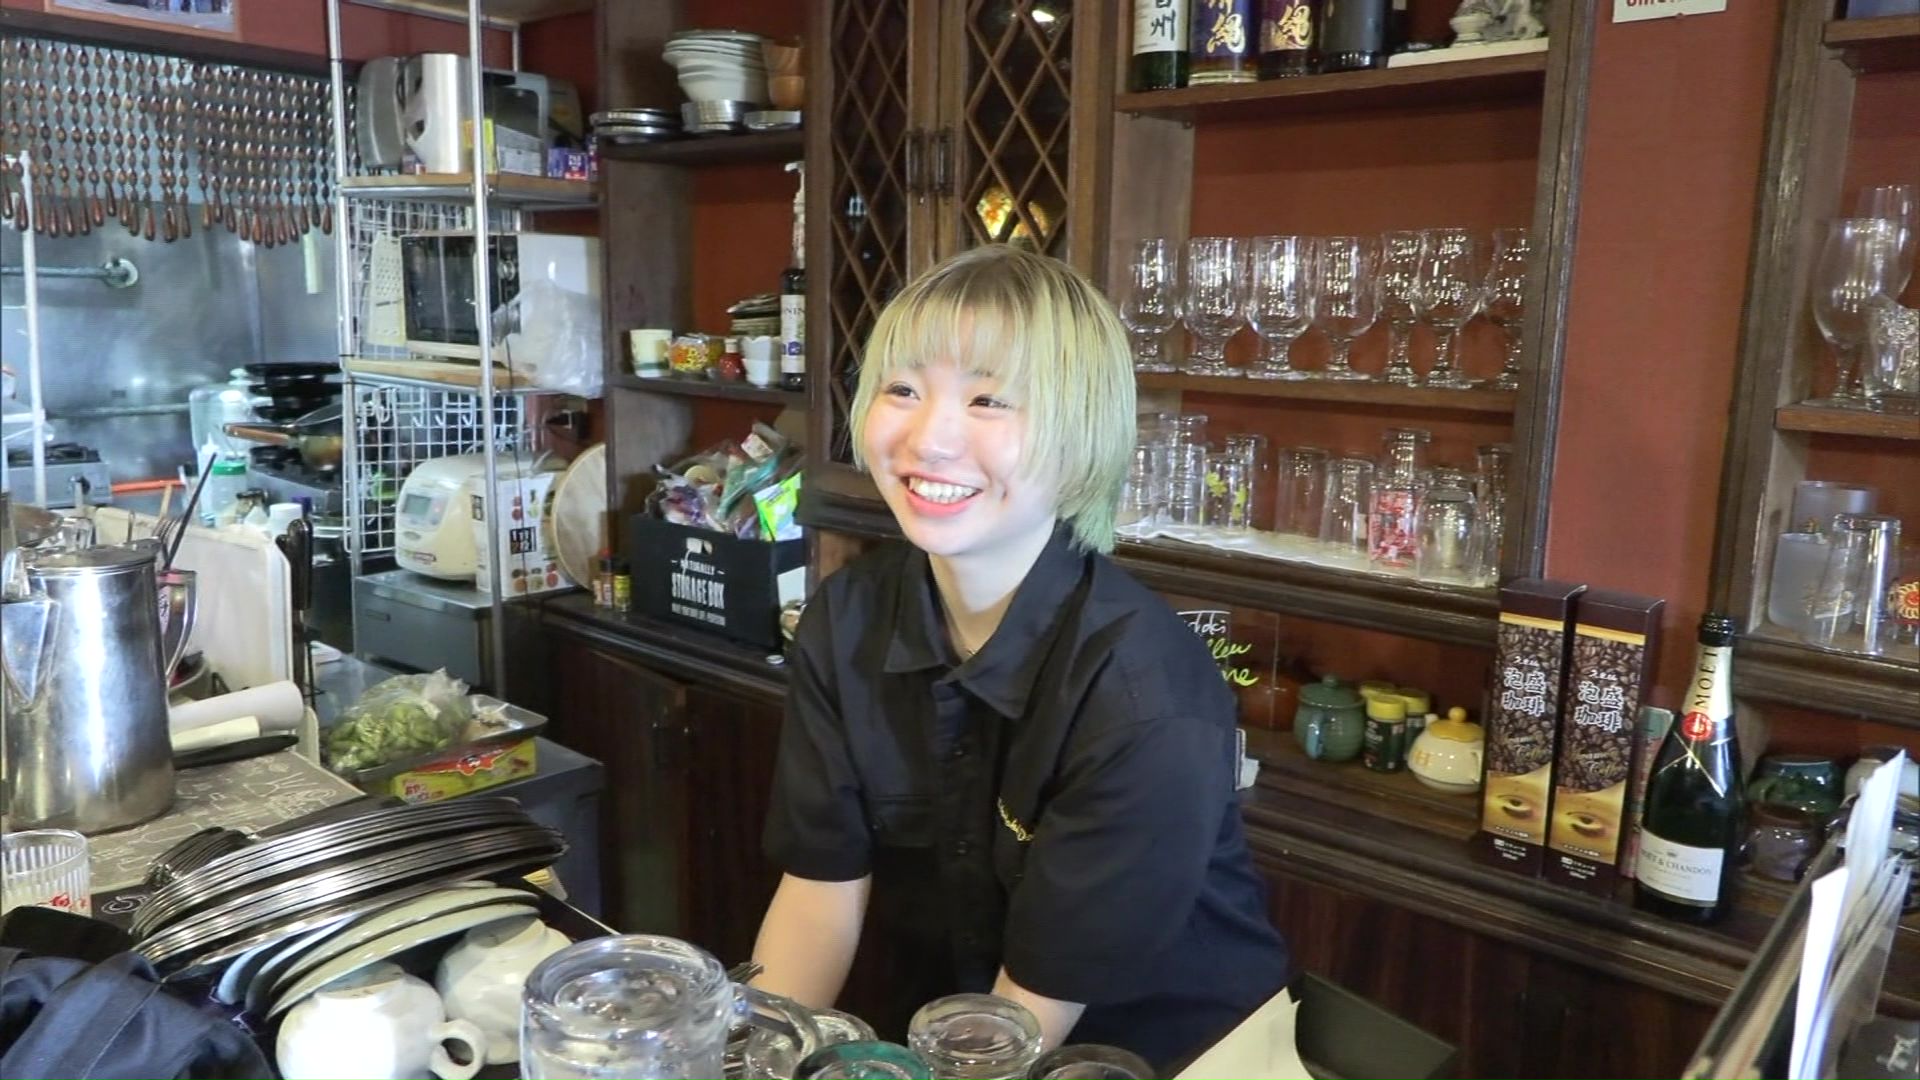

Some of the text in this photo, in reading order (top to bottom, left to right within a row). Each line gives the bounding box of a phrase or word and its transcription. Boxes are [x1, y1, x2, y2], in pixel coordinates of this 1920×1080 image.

[1151, 0, 1176, 41] 州
[1503, 667, 1547, 695] 泡盛
[1578, 680, 1624, 710] 泡盛
[1501, 690, 1545, 718] 珈琲
[1574, 704, 1622, 734] 珈琲
